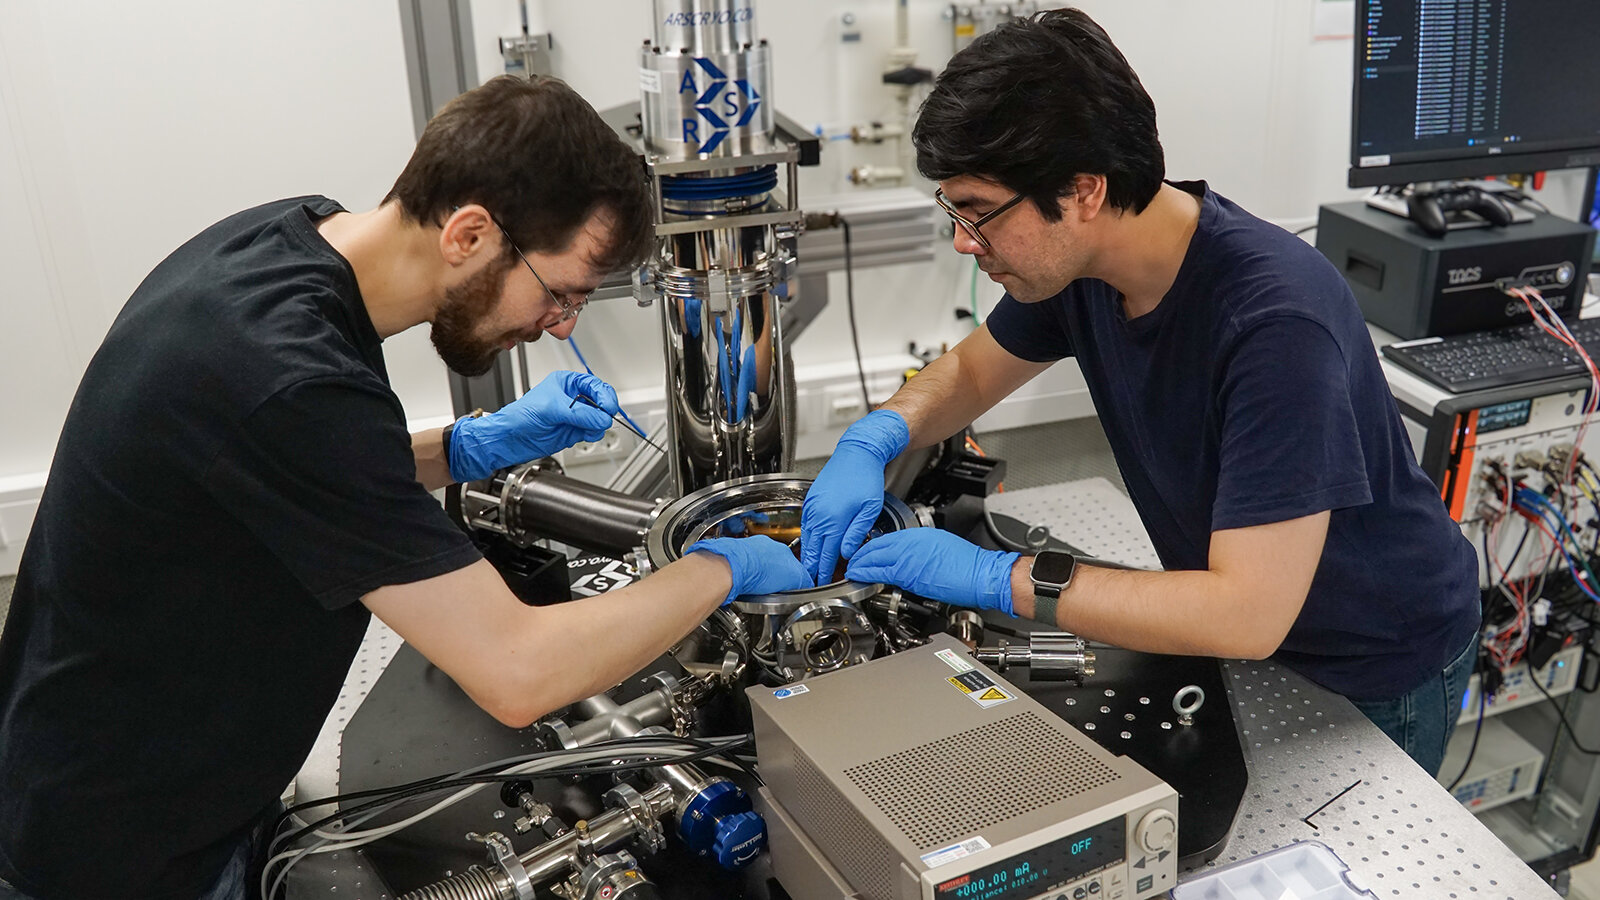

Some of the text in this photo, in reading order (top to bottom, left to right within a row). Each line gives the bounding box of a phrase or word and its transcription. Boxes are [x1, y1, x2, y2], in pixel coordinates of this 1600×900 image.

[679, 69, 698, 94] A
[724, 91, 739, 117] S
[682, 119, 700, 144] R
[592, 577, 608, 591] S
[1071, 837, 1093, 855] OFF
[956, 870, 1008, 898] +000.00
[1015, 862, 1030, 877] mA
